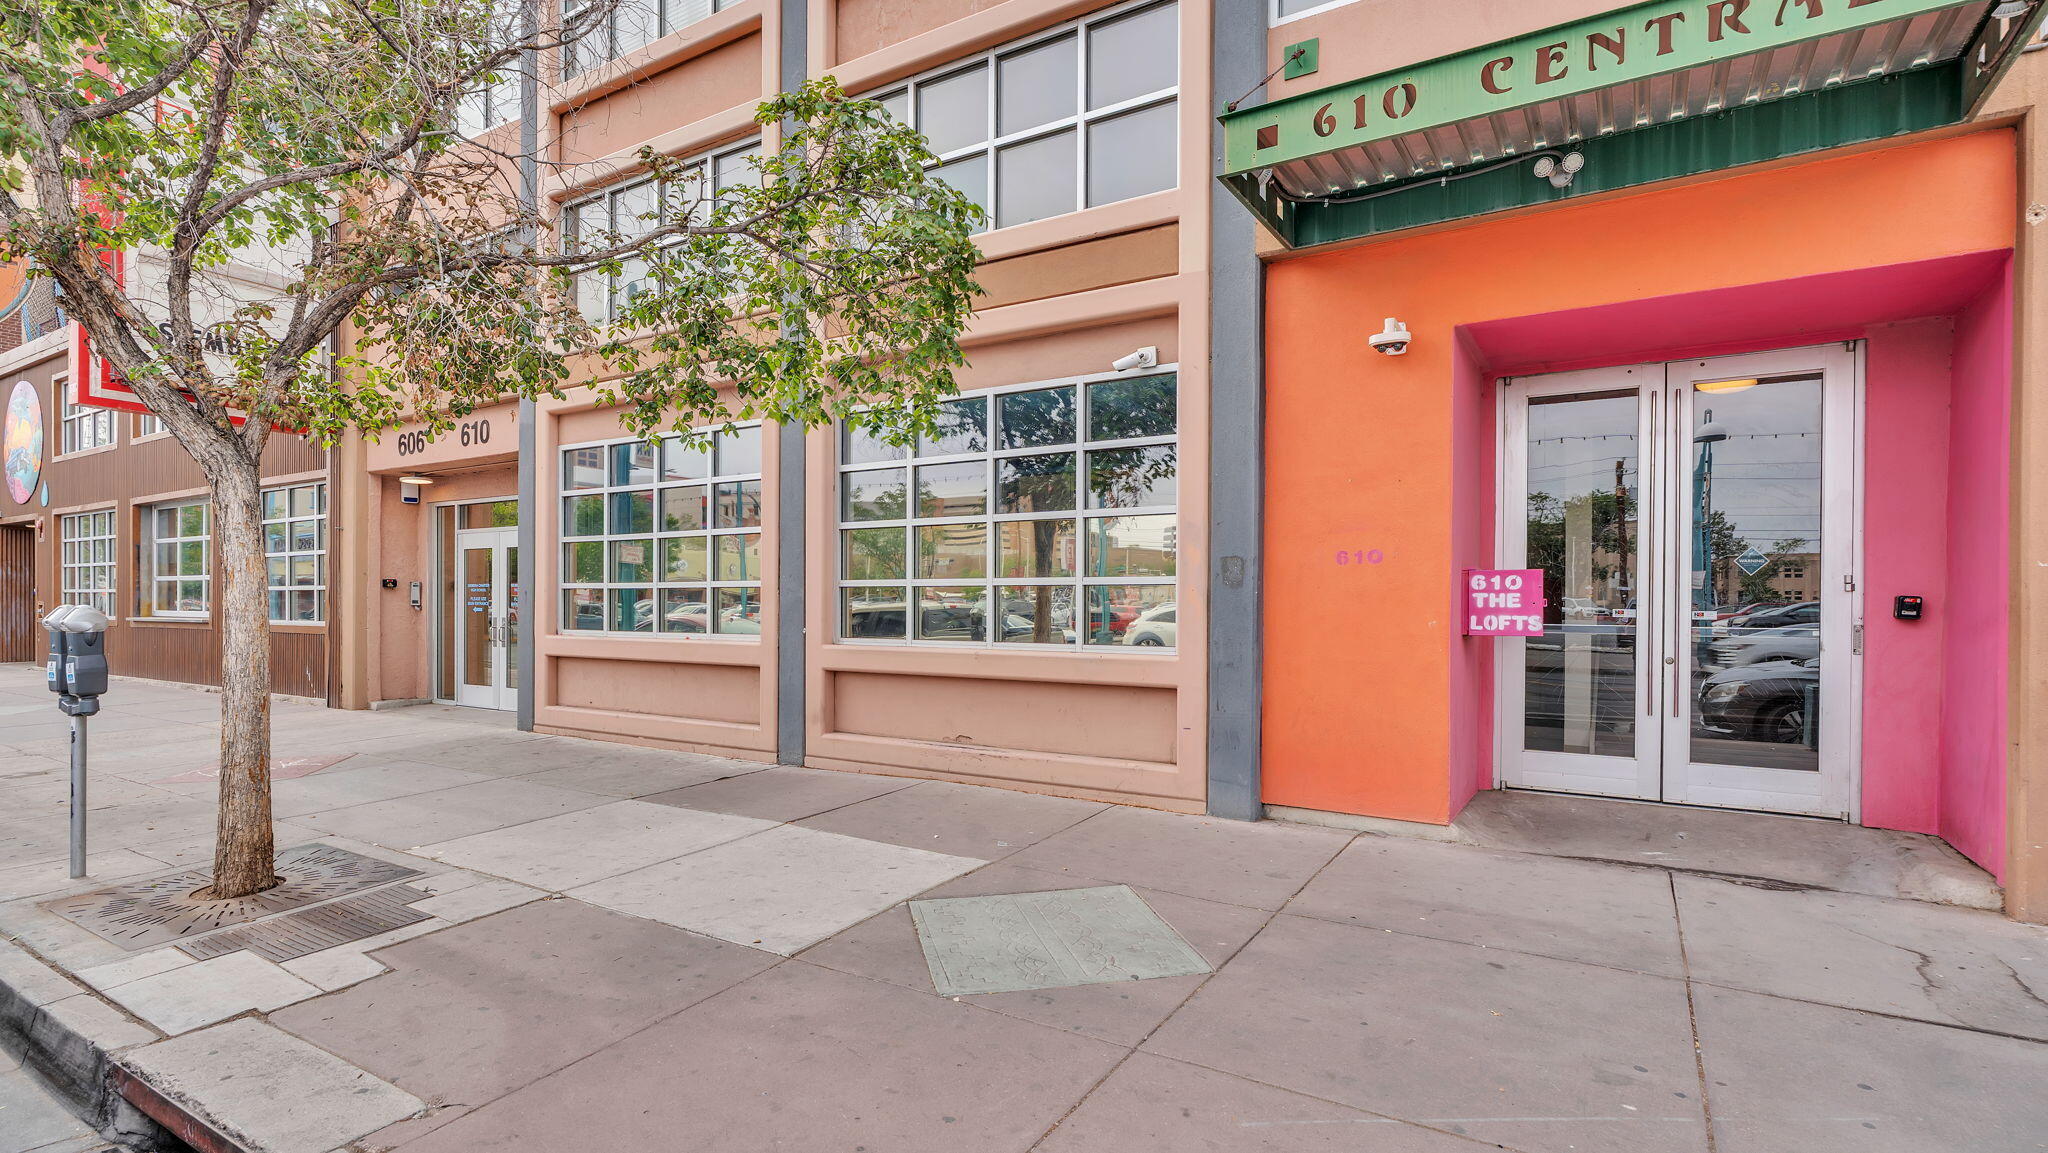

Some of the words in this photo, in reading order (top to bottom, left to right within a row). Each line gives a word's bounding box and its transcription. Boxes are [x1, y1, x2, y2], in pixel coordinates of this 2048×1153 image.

[1313, 83, 1417, 138] 610
[1480, 0, 1881, 95] CENTRA
[398, 430, 425, 457] 606
[461, 419, 490, 447] 610
[1335, 550, 1384, 566] 610
[1471, 575, 1523, 591] 610
[1472, 592, 1522, 608] THE
[1470, 615, 1543, 632] LOFTS
